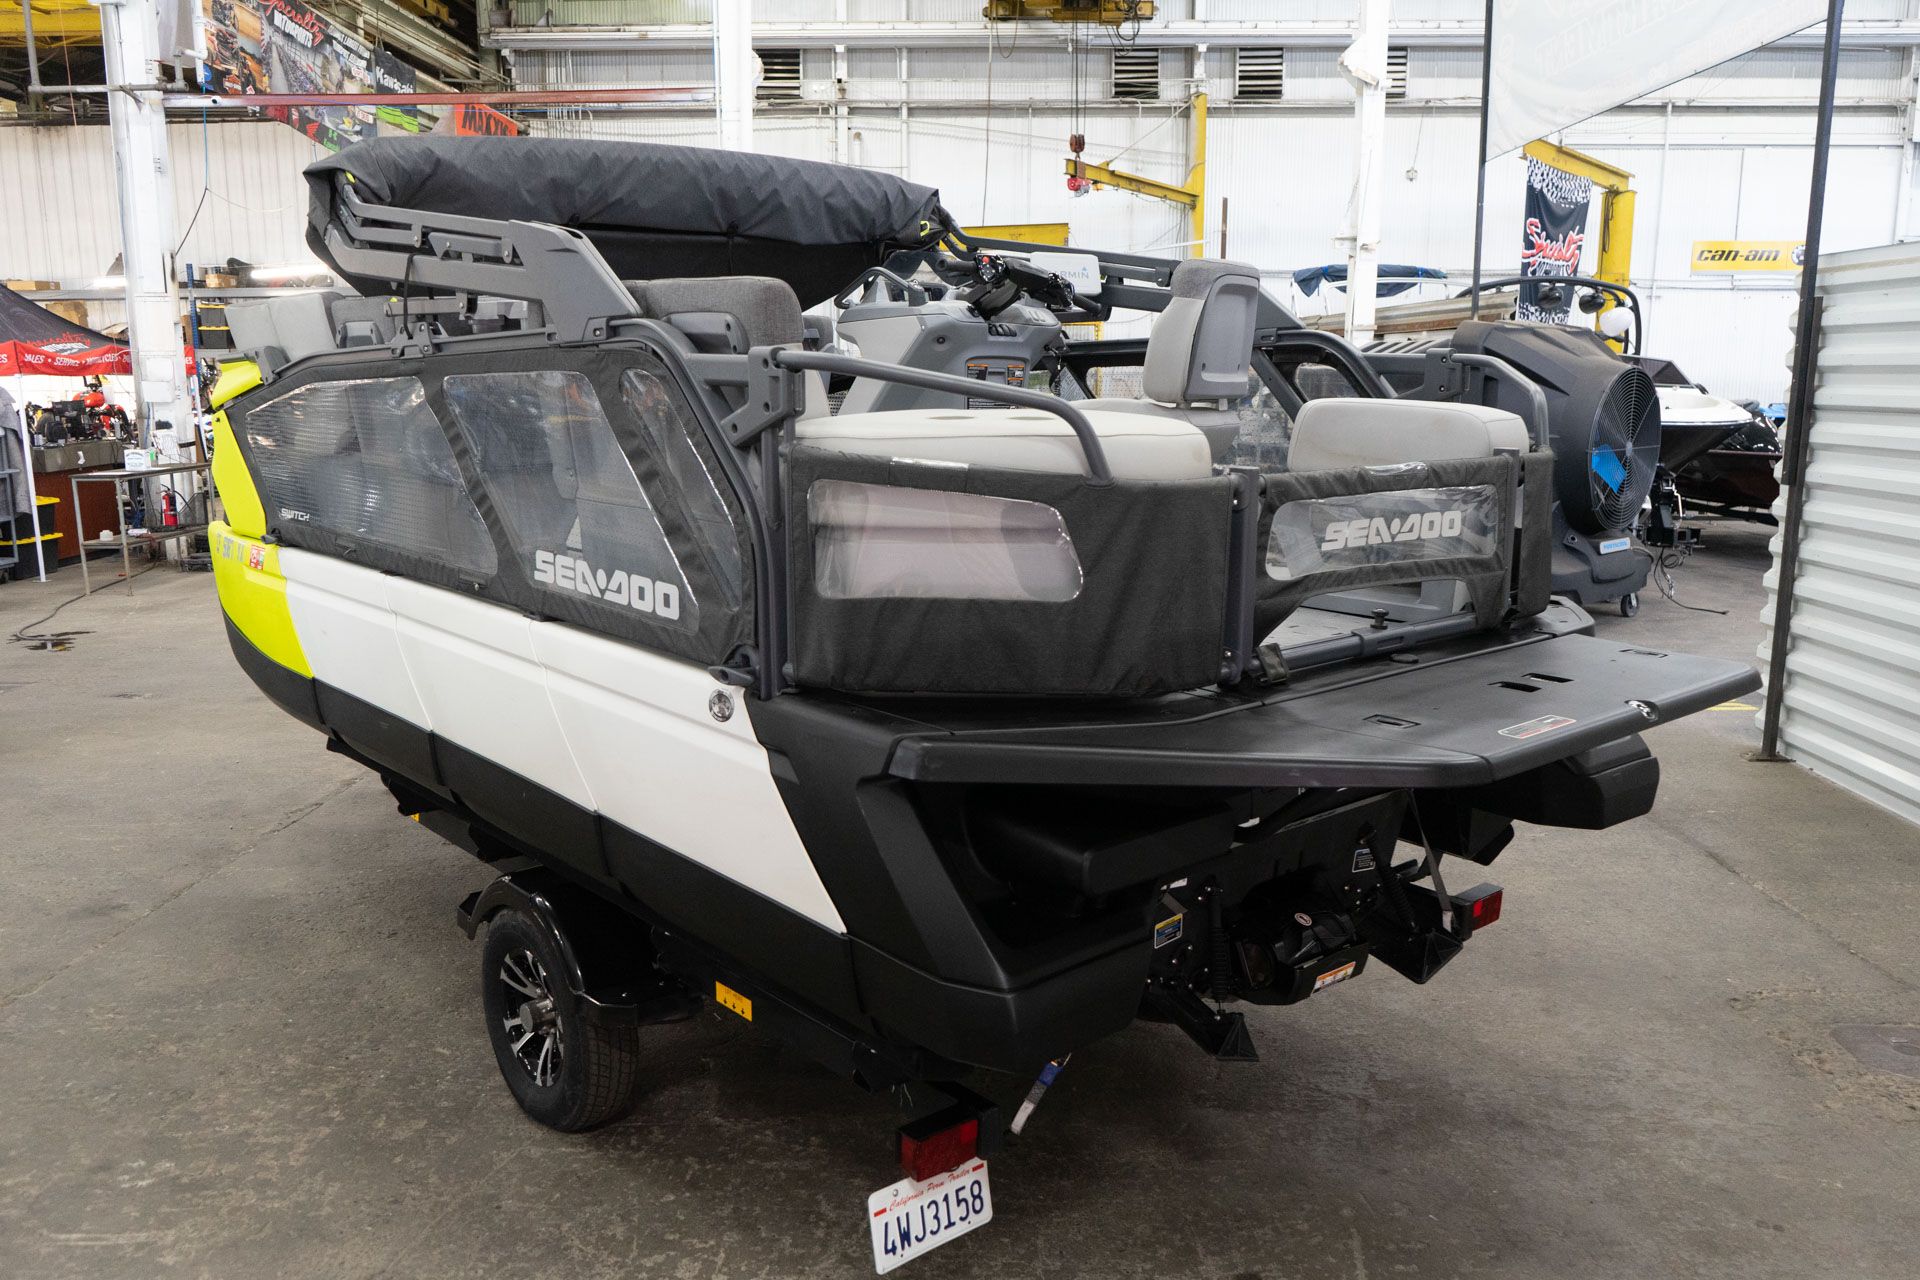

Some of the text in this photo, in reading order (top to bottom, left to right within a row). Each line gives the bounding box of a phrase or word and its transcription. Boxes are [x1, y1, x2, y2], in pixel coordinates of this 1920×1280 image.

[1697, 249, 1780, 261] can-am
[1060, 270, 1089, 280] RMIN
[281, 508, 310, 521] SWITCH
[889, 1168, 970, 1211] California Perm Trailer
[883, 1179, 984, 1257] 4WJ3158
